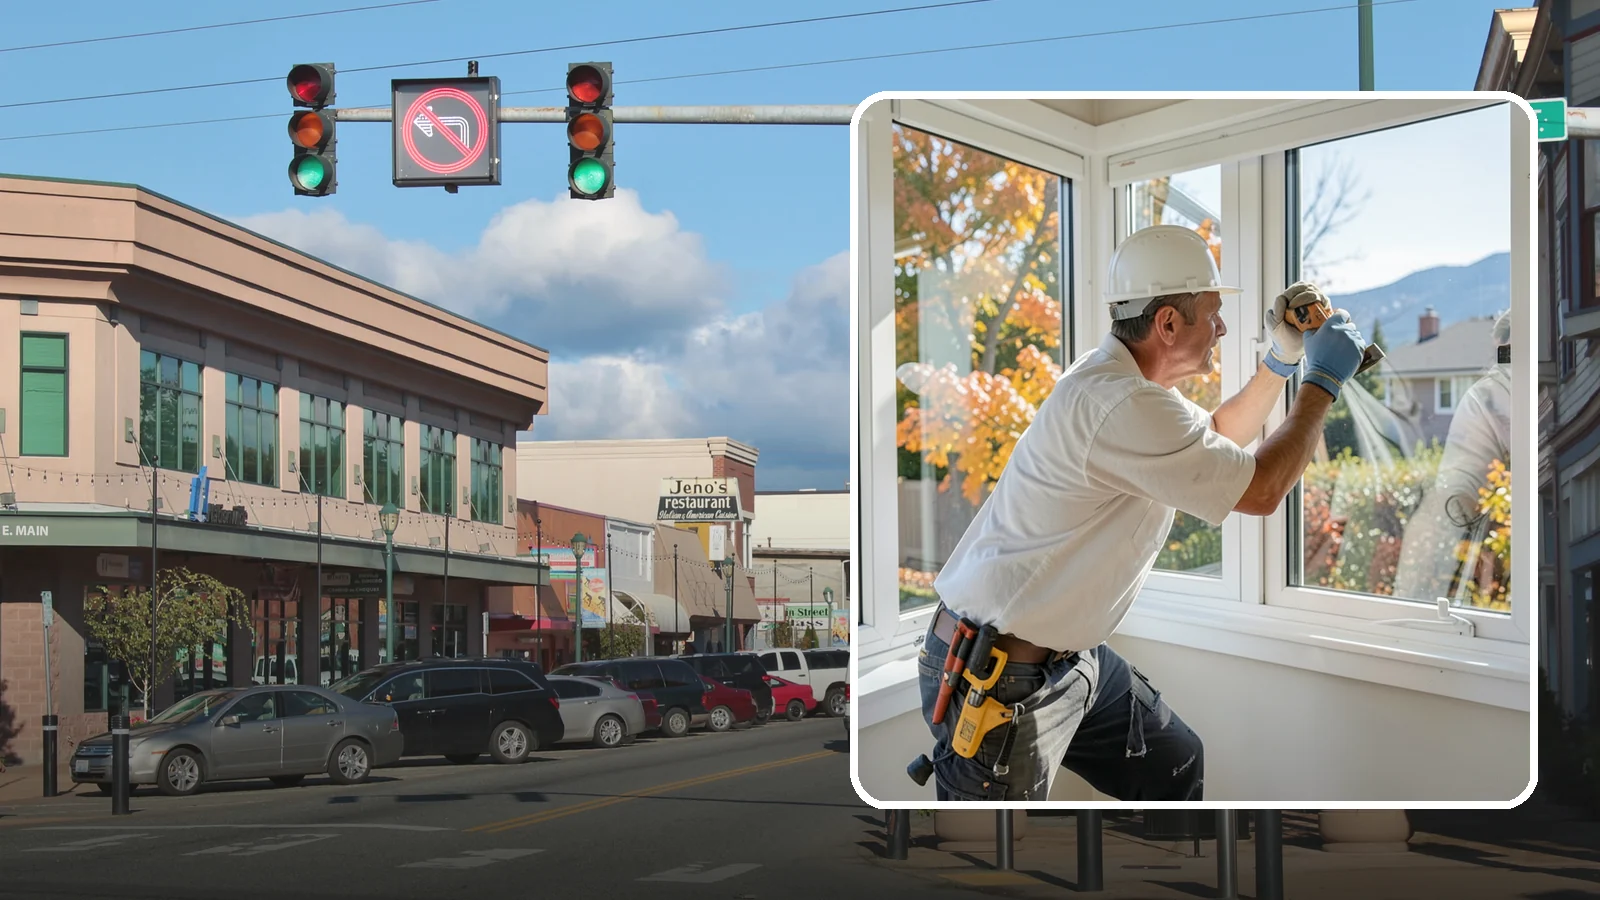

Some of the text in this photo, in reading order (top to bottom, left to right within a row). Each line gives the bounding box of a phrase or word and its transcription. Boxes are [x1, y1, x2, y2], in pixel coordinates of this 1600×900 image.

[669, 480, 727, 494] Jeno's
[665, 496, 731, 508] restaurant
[658, 510, 682, 519] Italian
[685, 509, 714, 519] American
[714, 509, 738, 519] Cuisine
[2, 525, 49, 536] E. MAIN
[797, 607, 828, 616] Street
